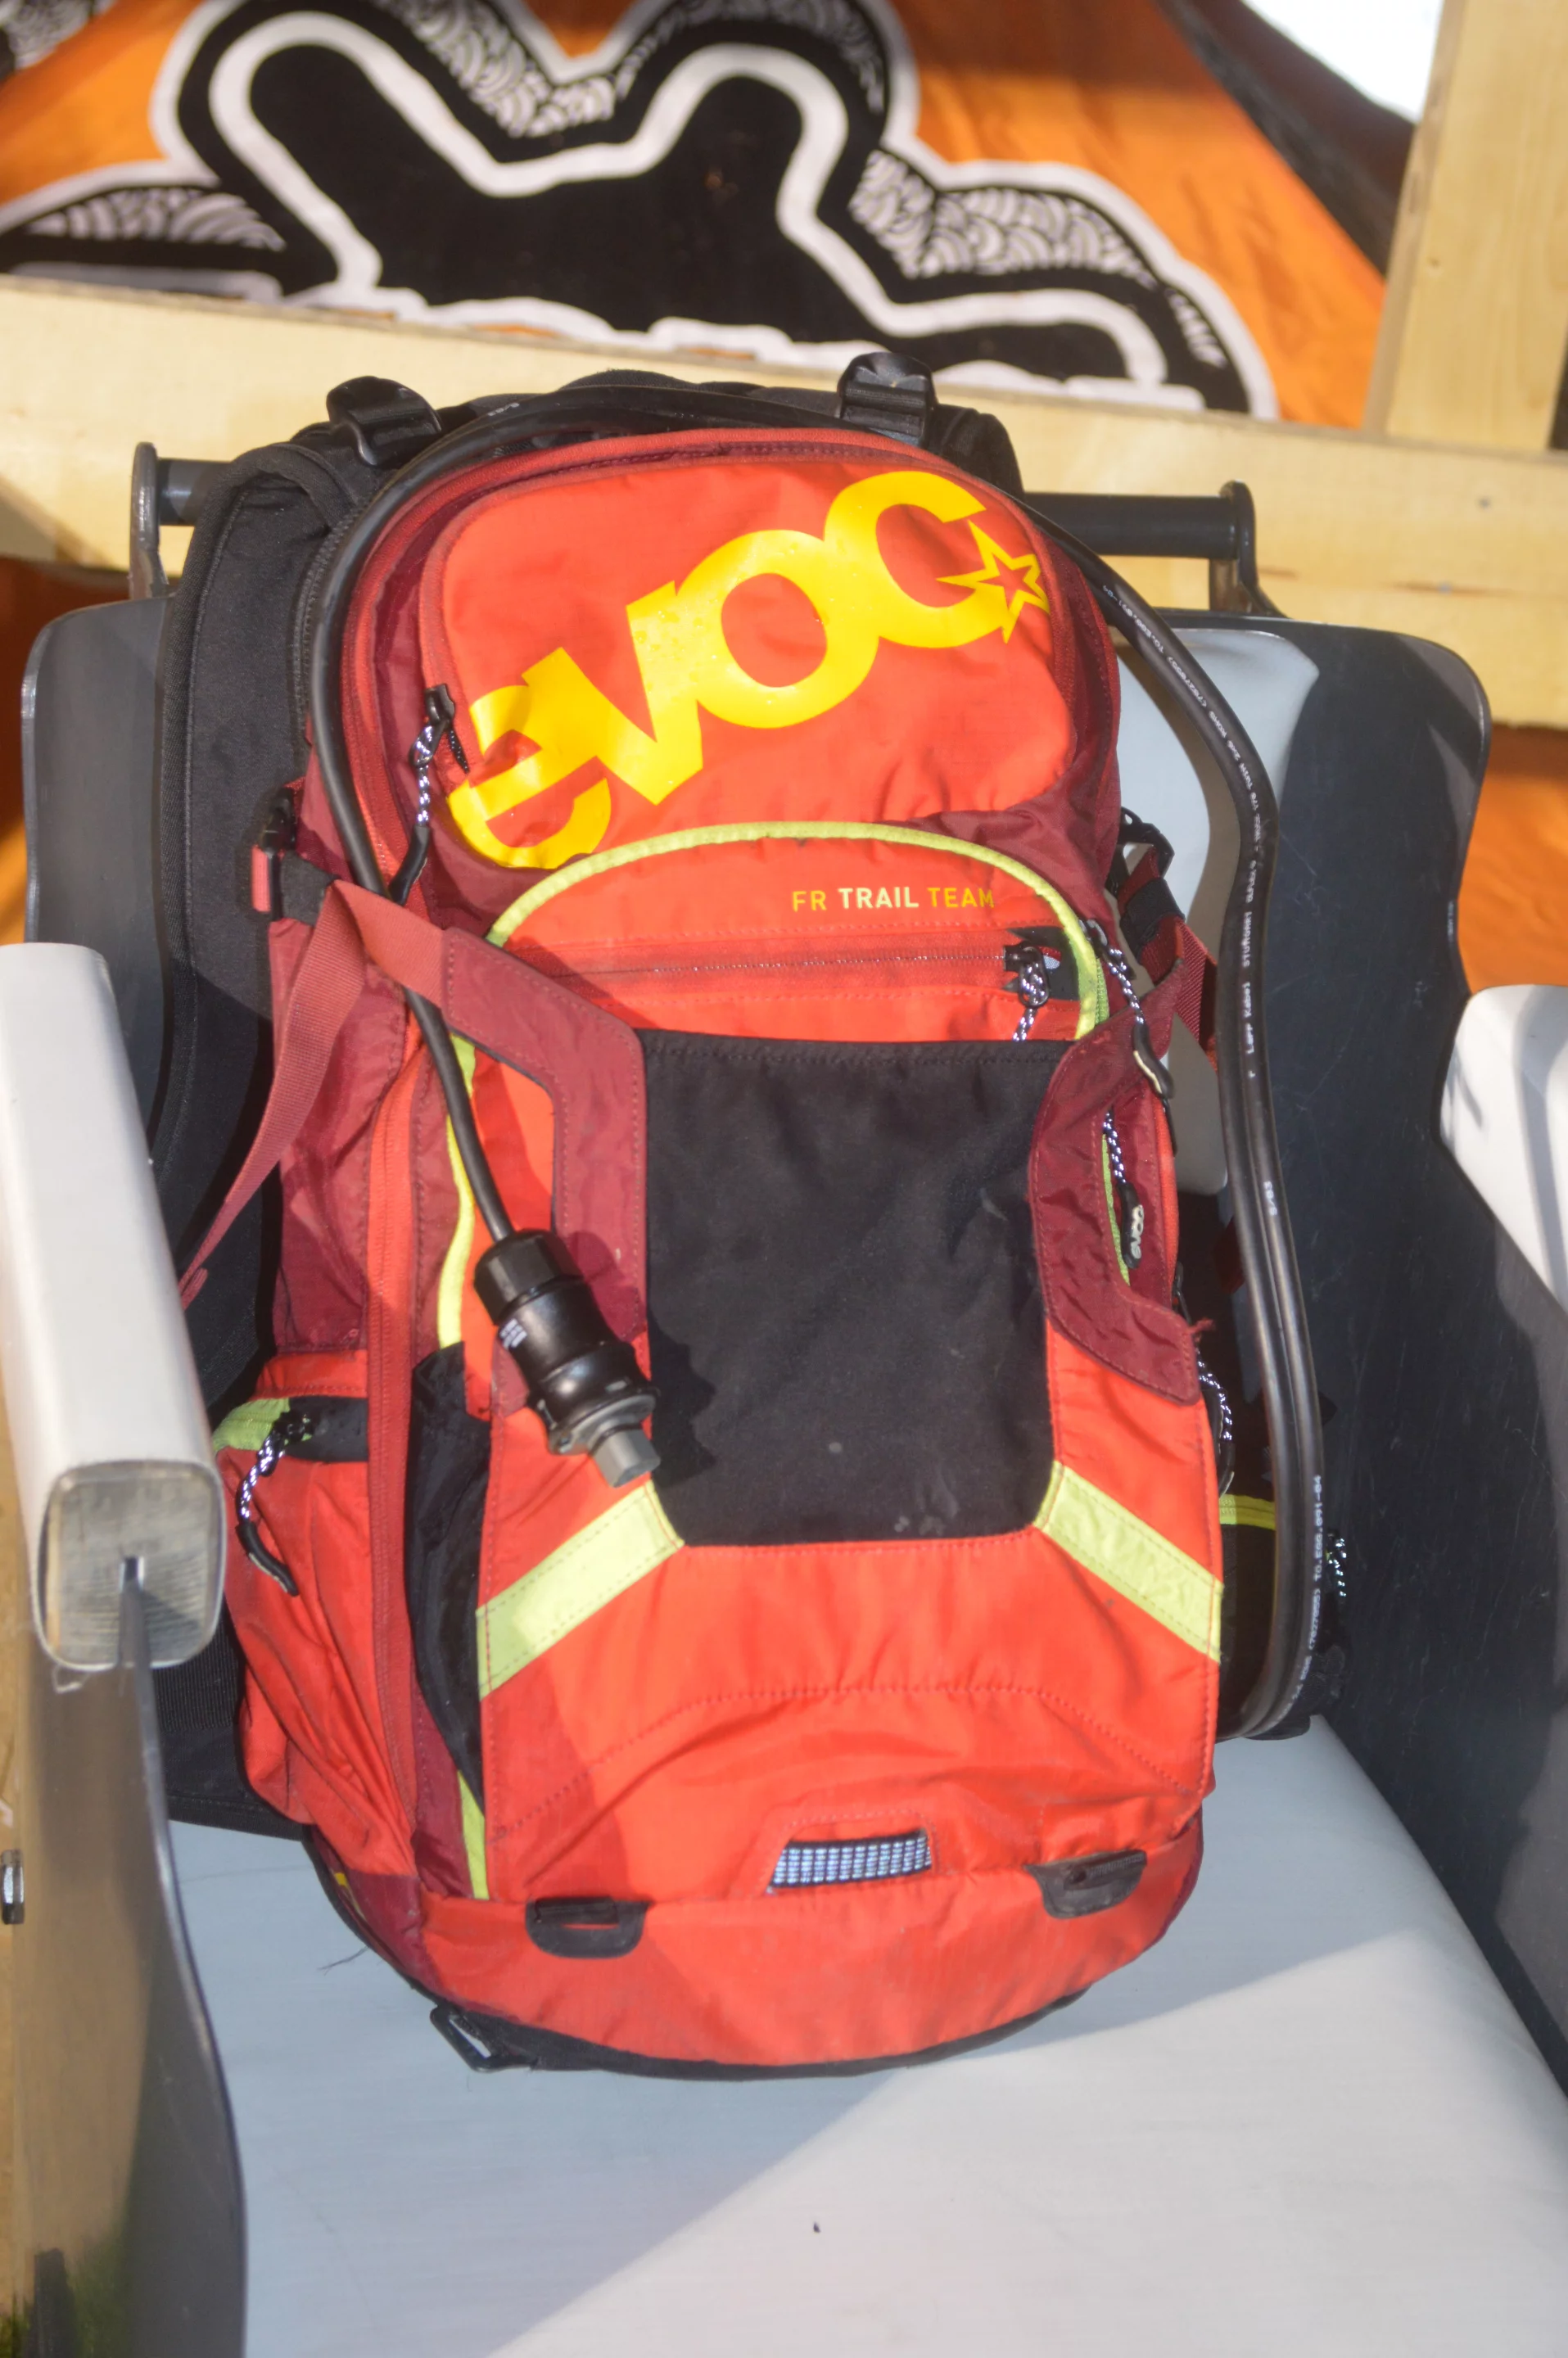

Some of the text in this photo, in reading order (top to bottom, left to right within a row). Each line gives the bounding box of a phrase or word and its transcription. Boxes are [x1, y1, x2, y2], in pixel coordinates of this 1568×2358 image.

[792, 886, 995, 912] FR TRAIL TEAM
[1242, 981, 1253, 1019] Kabel
